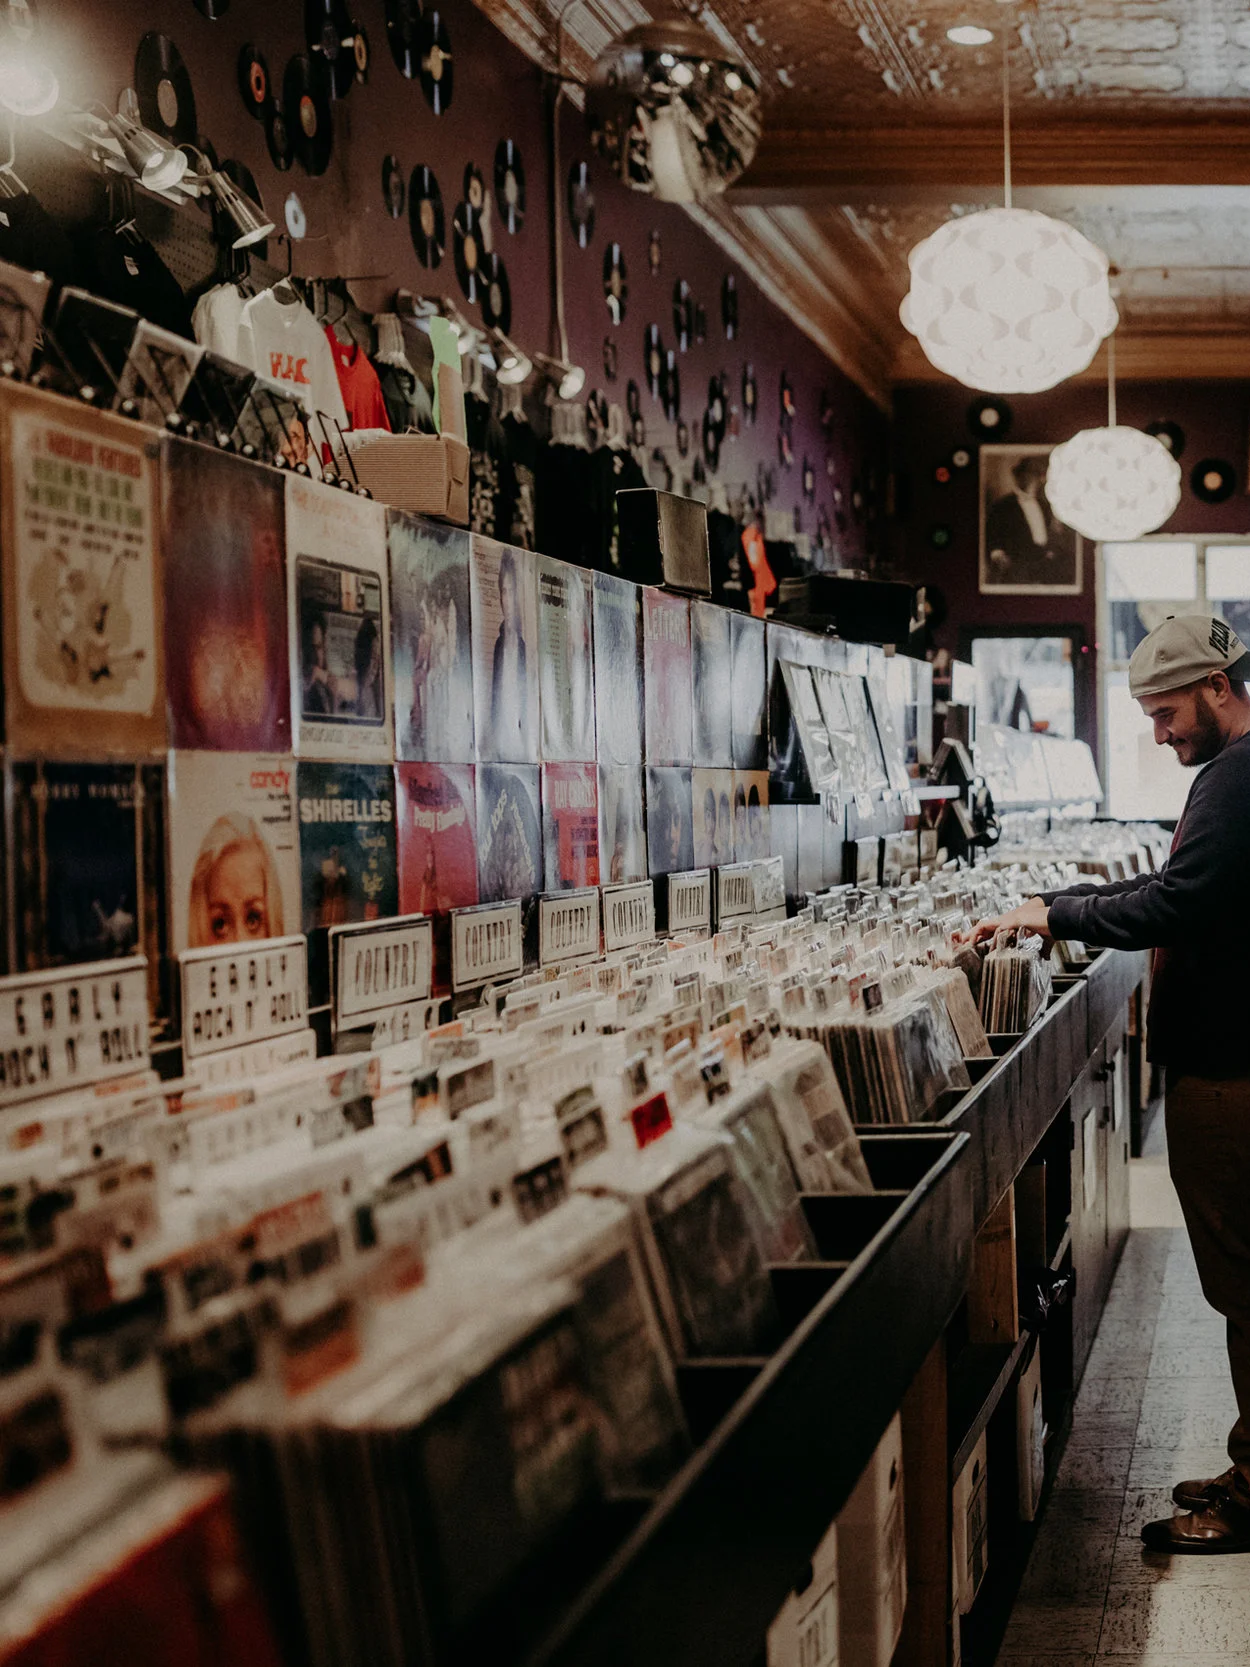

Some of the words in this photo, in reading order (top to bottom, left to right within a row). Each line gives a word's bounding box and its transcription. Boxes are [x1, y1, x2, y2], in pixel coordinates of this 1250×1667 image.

[299, 798, 392, 823] SHIRELLES
[550, 905, 592, 949] COUNTRY
[612, 896, 648, 938] COUNTRY
[465, 918, 513, 967] COUNTRY
[208, 953, 288, 999] EARLY
[354, 940, 420, 997] COUNTRY
[14, 981, 122, 1037] EARLY
